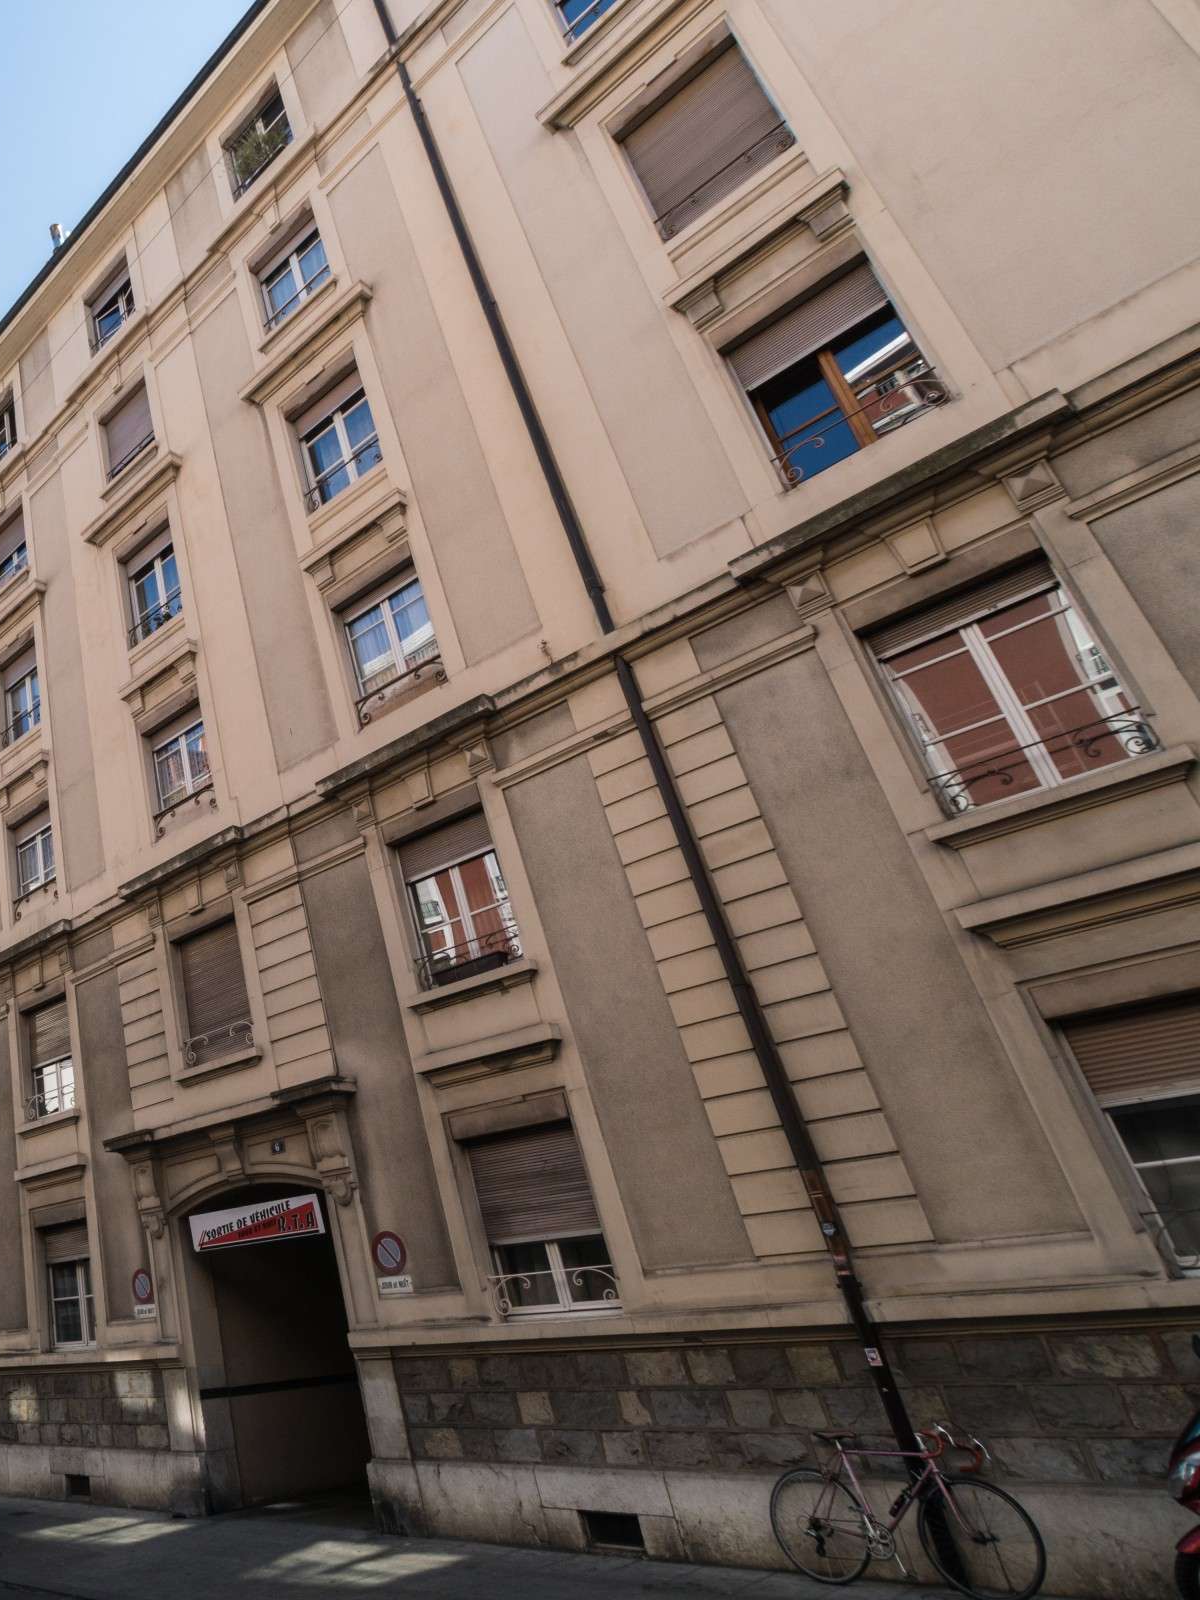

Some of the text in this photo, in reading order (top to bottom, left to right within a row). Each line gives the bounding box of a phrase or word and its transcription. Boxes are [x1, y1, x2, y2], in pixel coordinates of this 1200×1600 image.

[205, 1200, 291, 1240] SORTIE DE VÉHICULE
